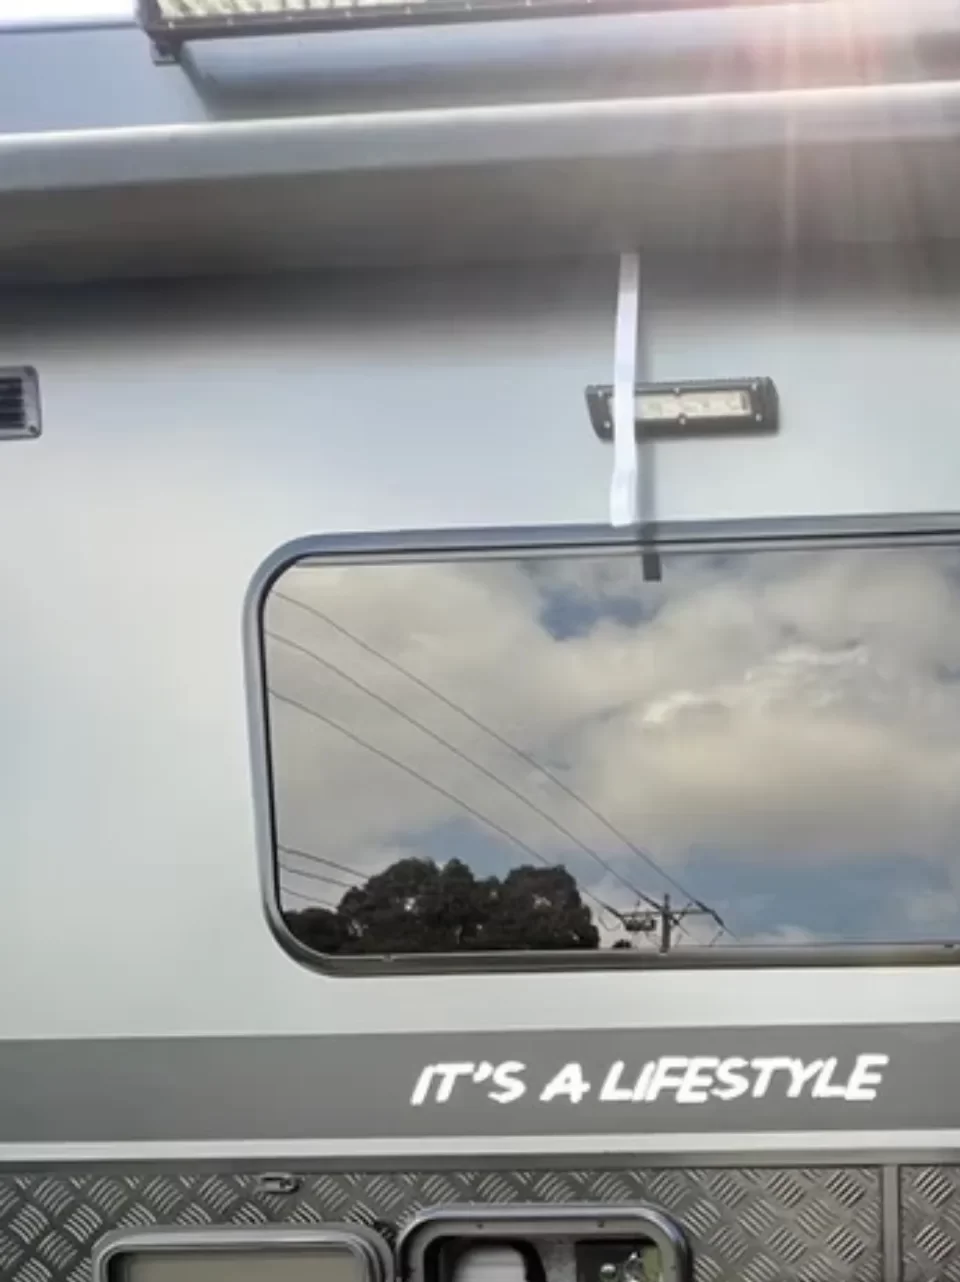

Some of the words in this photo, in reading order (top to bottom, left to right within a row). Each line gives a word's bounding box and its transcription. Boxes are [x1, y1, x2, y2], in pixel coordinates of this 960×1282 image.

[410, 1060, 527, 1105] IT'S
[539, 1062, 591, 1103] A
[599, 1053, 890, 1103] LIFESTYLE
